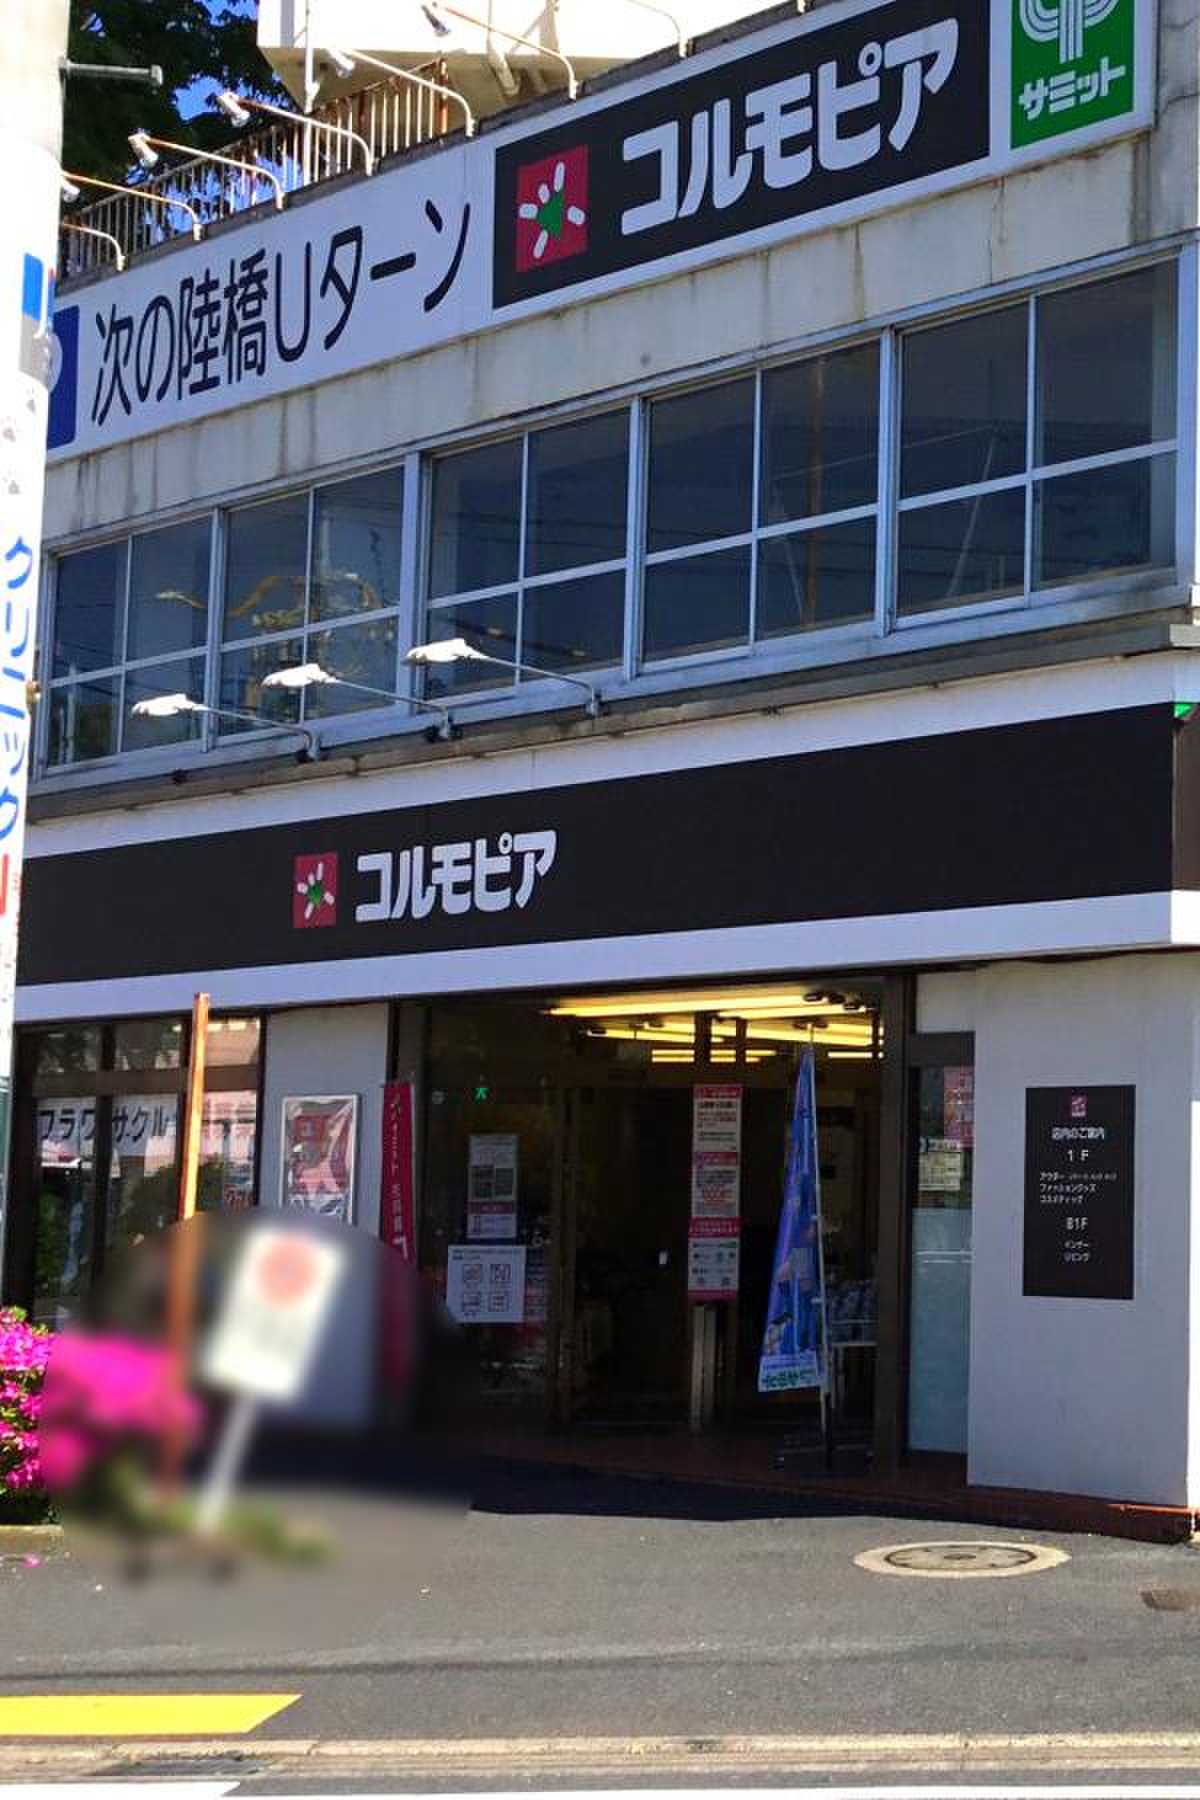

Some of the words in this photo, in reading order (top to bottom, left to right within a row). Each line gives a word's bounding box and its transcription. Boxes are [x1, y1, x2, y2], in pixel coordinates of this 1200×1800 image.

[621, 17, 959, 236] コルモピア
[1018, 56, 1126, 121] サミット
[91, 200, 471, 427] 次の陸橋Uターン
[355, 829, 557, 923] コルモピア
[1066, 1217, 1089, 1231] B1F
